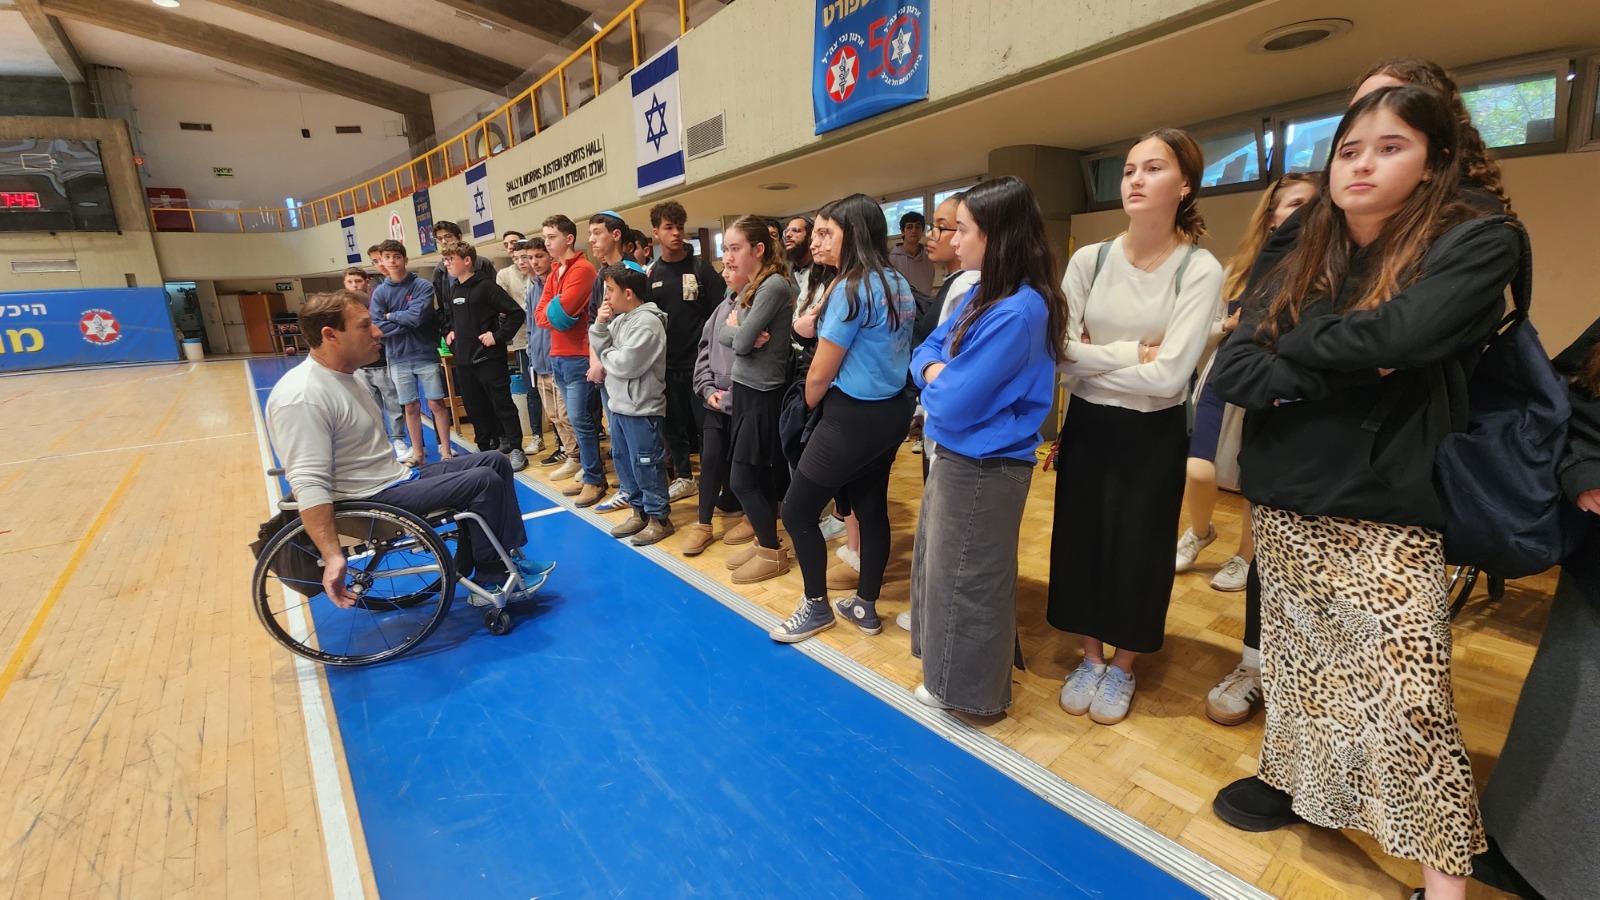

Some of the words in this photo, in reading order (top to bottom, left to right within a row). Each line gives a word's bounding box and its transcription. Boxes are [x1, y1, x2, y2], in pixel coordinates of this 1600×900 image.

[898, 6, 906, 15] נכי
[838, 33, 849, 43] נכי
[849, 32, 865, 48] ארגון
[867, 14, 921, 79] 50
[506, 177, 519, 193] SALLY
[519, 176, 523, 187] &
[523, 167, 542, 186] MORRIS
[563, 146, 586, 167] SPORTS
[585, 138, 602, 157] HALL
[588, 158, 604, 176] אולם
